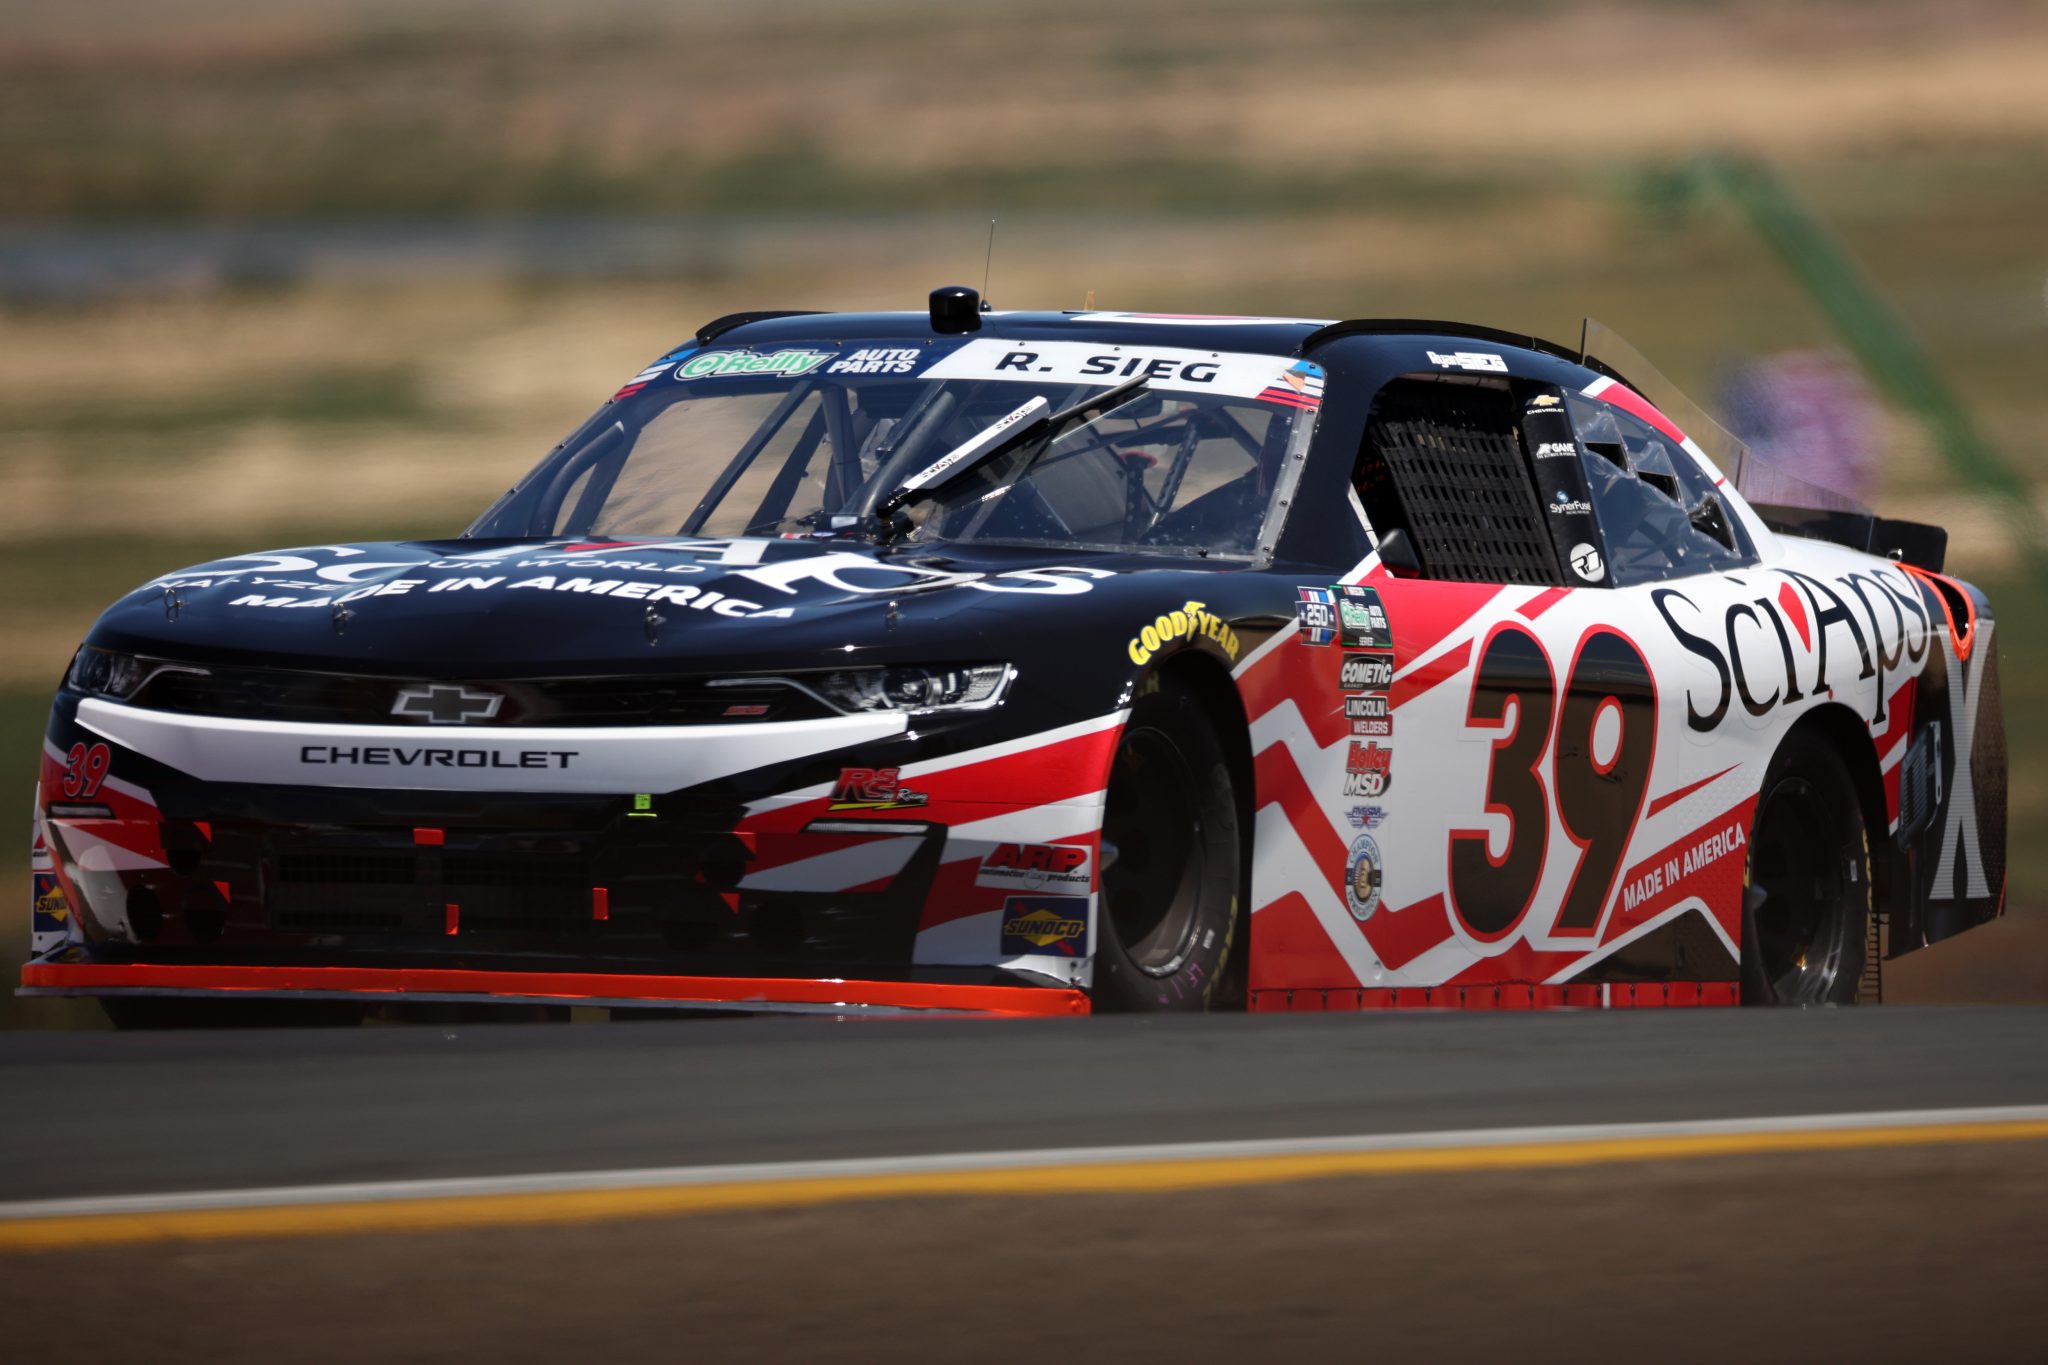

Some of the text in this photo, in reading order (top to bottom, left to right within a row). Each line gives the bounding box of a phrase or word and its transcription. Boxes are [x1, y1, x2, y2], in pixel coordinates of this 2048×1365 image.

[677, 350, 837, 380] O'Reilly
[827, 360, 917, 374] PARTS
[846, 349, 921, 361] AUTO
[995, 352, 1222, 383] R. SIEG
[1550, 500, 1592, 514] SynerFuse
[516, 560, 706, 574] WORLD
[228, 576, 797, 619] MADE IN AMERICA
[1306, 603, 1329, 626] 250
[1127, 601, 1240, 666] GOODYEAR
[1650, 567, 1927, 733] SciAps
[1341, 662, 1393, 685] COMETIC
[1345, 699, 1386, 717] LINCOLN
[1353, 721, 1389, 735] WELDERS
[64, 742, 111, 798] 39
[300, 746, 580, 769] CHEVROLET
[1346, 740, 1393, 778] Holley
[1344, 773, 1388, 798] MSD
[1448, 620, 1659, 944] 39
[981, 843, 1088, 873] ARP
[1623, 821, 1747, 913] MADE IN AMERICA
[1005, 919, 1082, 937] SUNOCO
